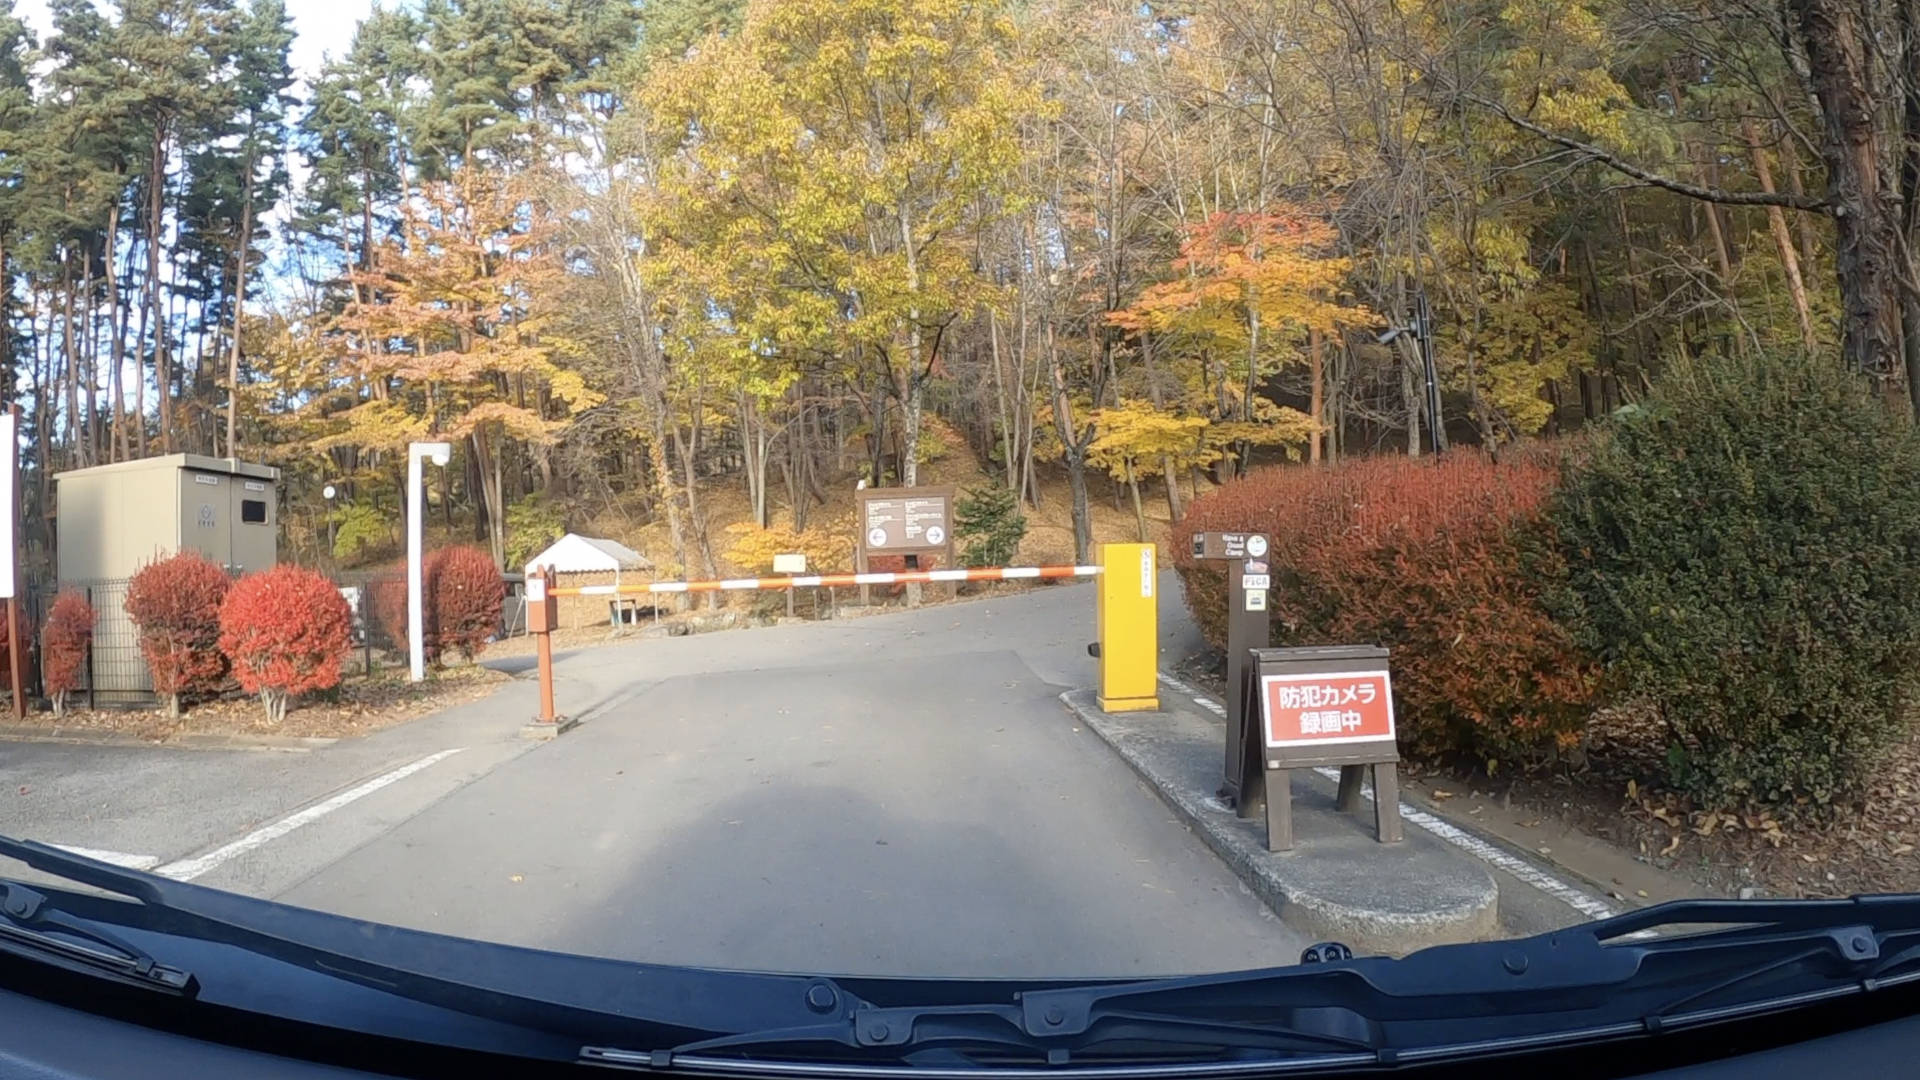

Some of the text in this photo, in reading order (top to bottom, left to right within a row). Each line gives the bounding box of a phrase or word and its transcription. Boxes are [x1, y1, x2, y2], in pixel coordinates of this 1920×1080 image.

[1279, 683, 1376, 709] 防犯カメラ
[1299, 709, 1361, 734] 録画中
